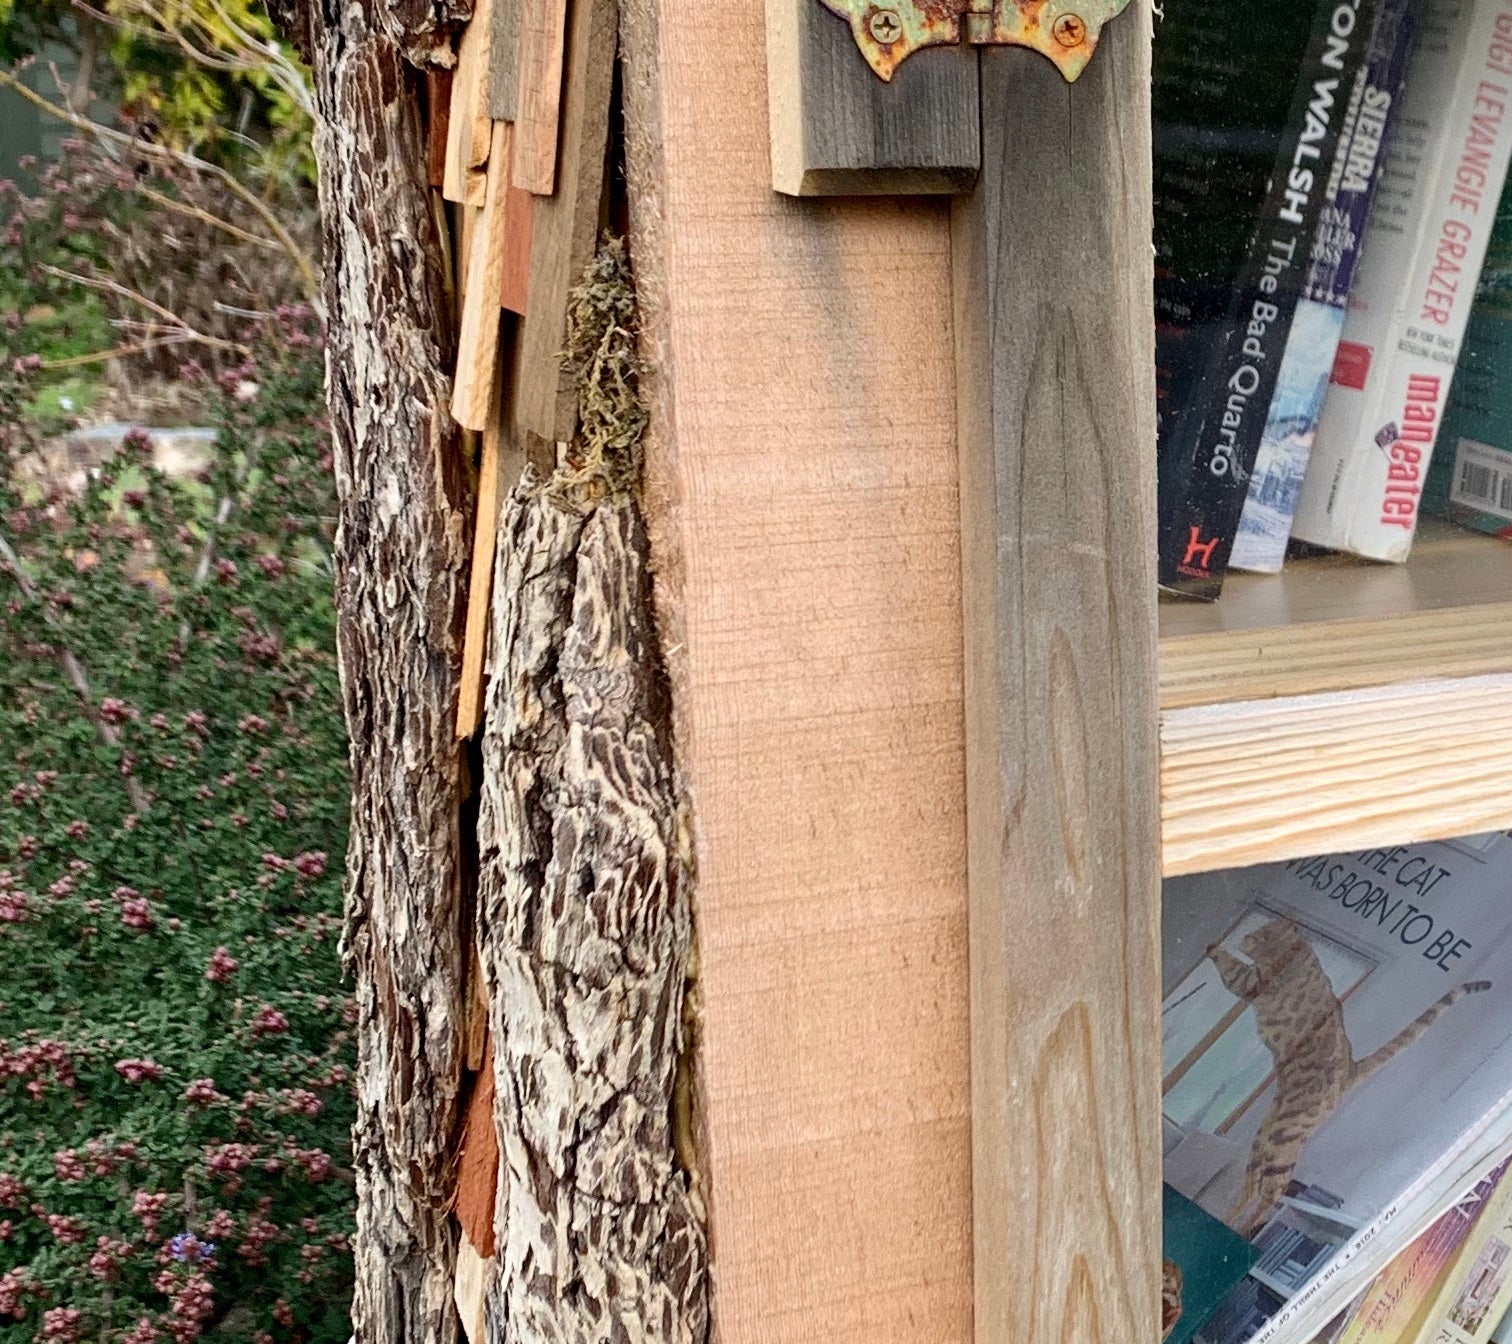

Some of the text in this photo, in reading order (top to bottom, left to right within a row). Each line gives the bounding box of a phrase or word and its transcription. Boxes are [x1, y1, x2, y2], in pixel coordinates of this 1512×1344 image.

[1278, 79, 1340, 224] WALSH
[1340, 84, 1392, 193] SIERRA
[1449, 79, 1510, 215] LEVANGIE
[1257, 236, 1297, 294] The
[1419, 219, 1472, 328] GRAZER
[1241, 301, 1279, 360] Bad
[1210, 364, 1260, 476] Quarto
[1380, 372, 1442, 530] maneater
[1285, 856, 1473, 973] WAS BORN TO BE
[1358, 847, 1452, 898] THE CAT
[1289, 1281, 1323, 1313] THRILL
[1321, 1261, 1342, 1282] THE
[1257, 1326, 1276, 1344] THE
[1275, 1311, 1292, 1327] OF
